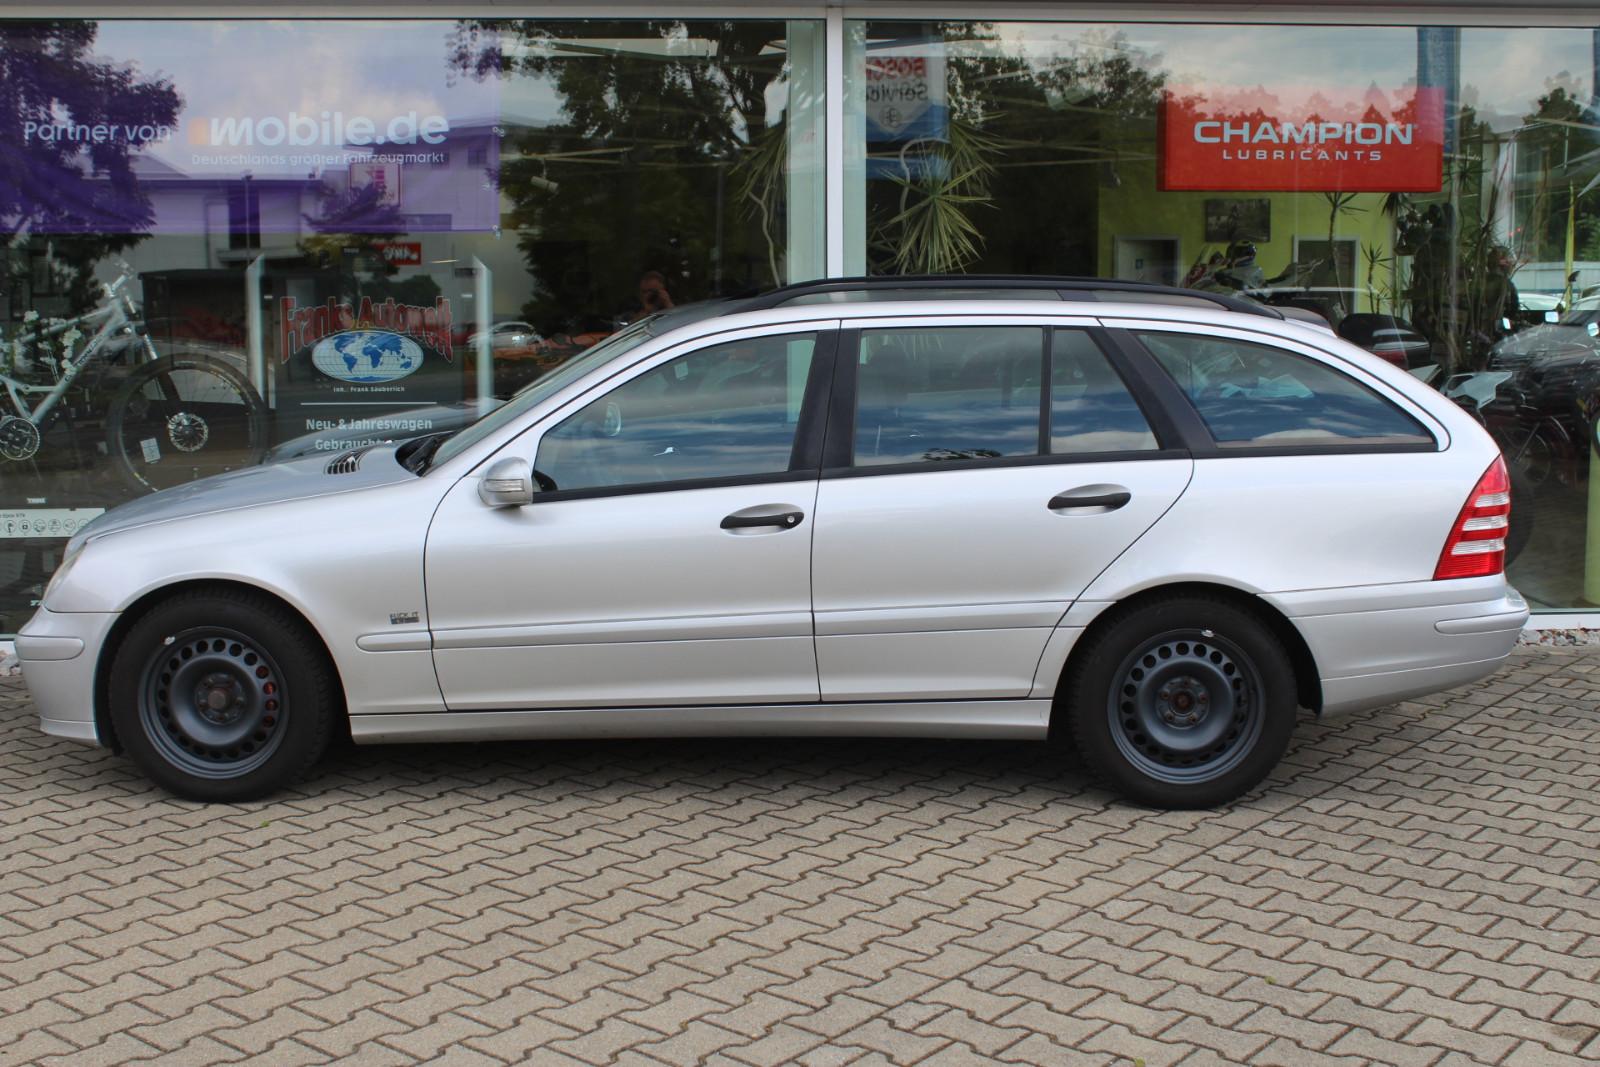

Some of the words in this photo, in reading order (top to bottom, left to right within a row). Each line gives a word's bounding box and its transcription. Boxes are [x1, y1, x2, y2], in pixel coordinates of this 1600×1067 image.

[24, 121, 119, 141] Partner
[125, 124, 171, 141] von
[210, 111, 449, 146] mobile.de
[1194, 121, 1413, 145] CHAMPION
[191, 151, 286, 166] Deutschlands
[288, 153, 340, 168] größter
[343, 151, 444, 167] Fahrzeugmarkt
[1223, 149, 1382, 160] LUBRICANTS
[357, 296, 453, 363] Autowelt
[305, 419, 336, 431] Neu-
[338, 419, 349, 430] &
[349, 419, 433, 432] Jahreswagen
